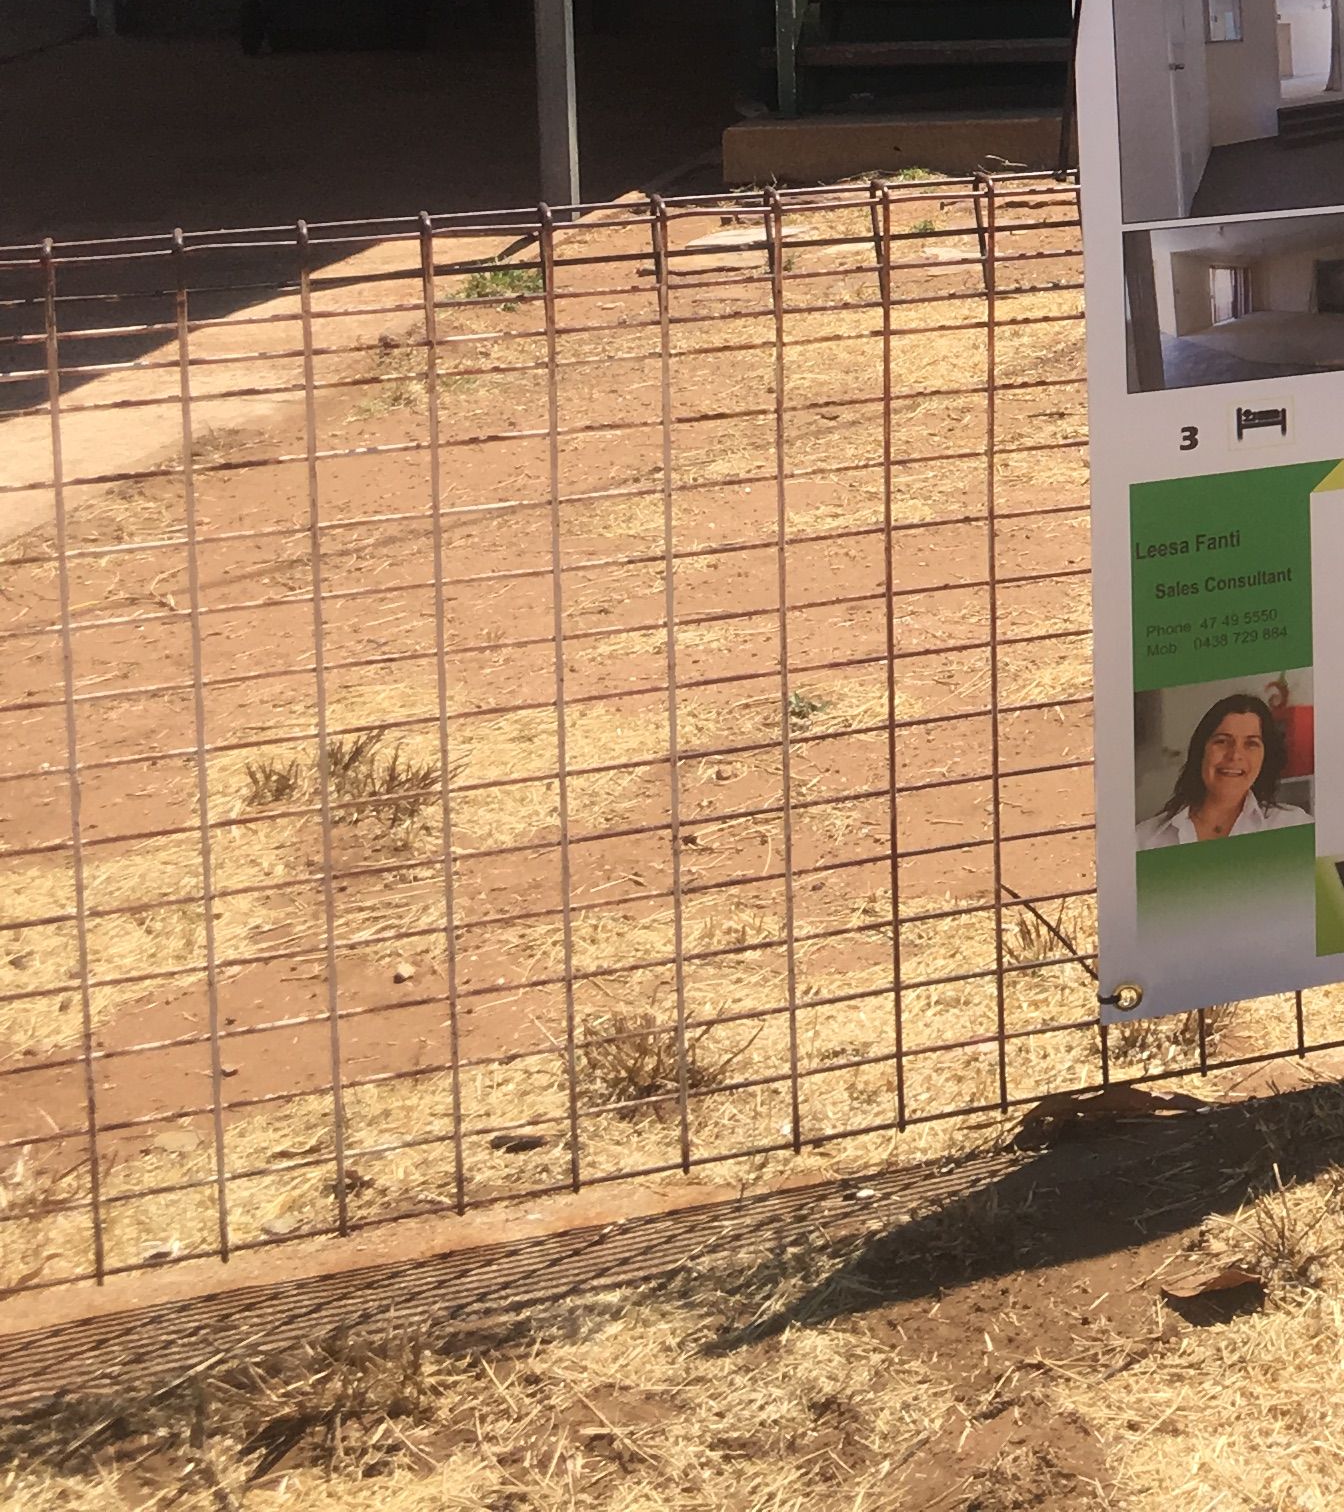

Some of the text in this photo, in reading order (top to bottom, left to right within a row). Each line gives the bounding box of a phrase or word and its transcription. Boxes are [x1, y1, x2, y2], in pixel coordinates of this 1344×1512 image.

[1179, 425, 1199, 451] 3
[1136, 530, 1241, 560] Leesa Fanti
[1155, 567, 1293, 600] Sales Consultant
[1146, 622, 1192, 637] Phone
[1200, 617, 1217, 630] 47
[1221, 614, 1239, 627] 49
[1147, 642, 1177, 657] Mob
